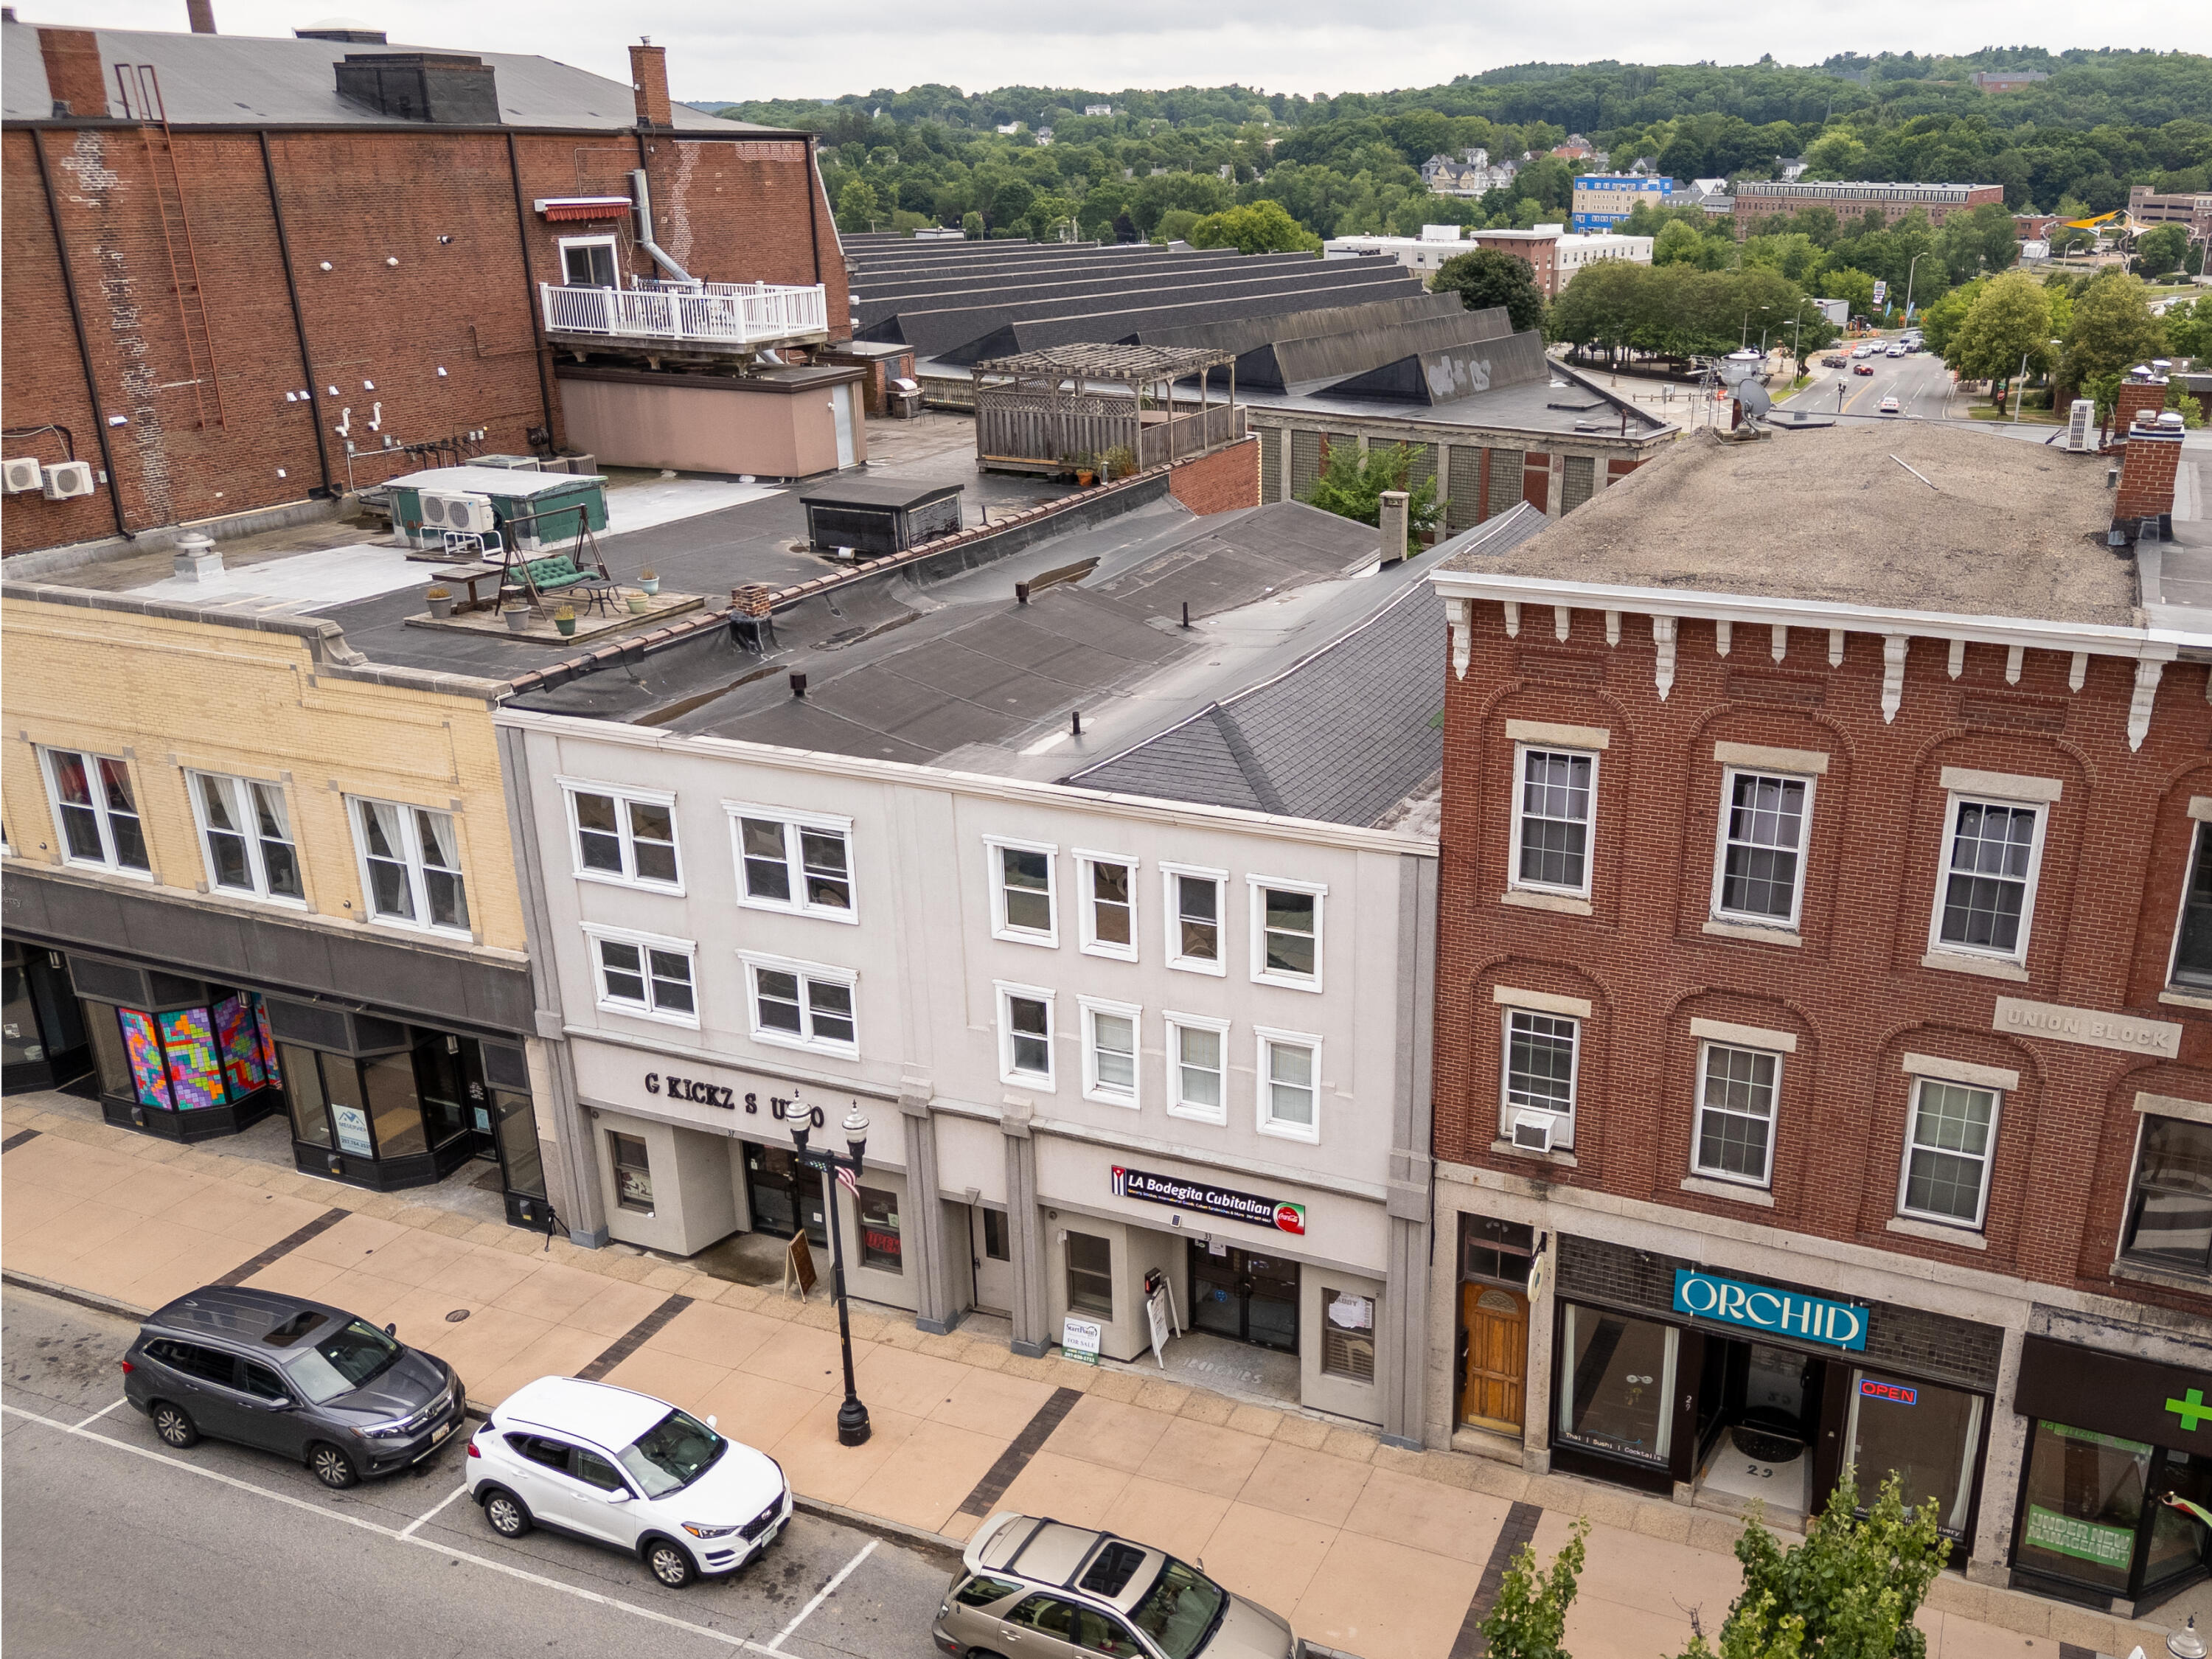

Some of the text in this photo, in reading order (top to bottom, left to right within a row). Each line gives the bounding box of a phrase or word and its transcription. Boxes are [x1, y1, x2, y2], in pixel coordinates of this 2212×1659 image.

[1, 896, 21, 908] erry
[2008, 1009, 2171, 1049] UNION BLOCK
[645, 1073, 660, 1093] G
[666, 1076, 735, 1110] KICKZ
[1128, 1175, 1271, 1216] LA Bodegita Cubitalian
[1204, 1233, 1211, 1241] 33
[1682, 1279, 1860, 1341] ORCHID
[1862, 1382, 1914, 1402] OPEN
[1565, 1432, 1662, 1461] Thai Sushi Cocktails
[1746, 1464, 1773, 1478] 29
[1938, 1526, 1961, 1537] ivery
[2028, 1525, 2129, 1561] MANAGEMENT
[2031, 1512, 2130, 1550] UNDER NEW
